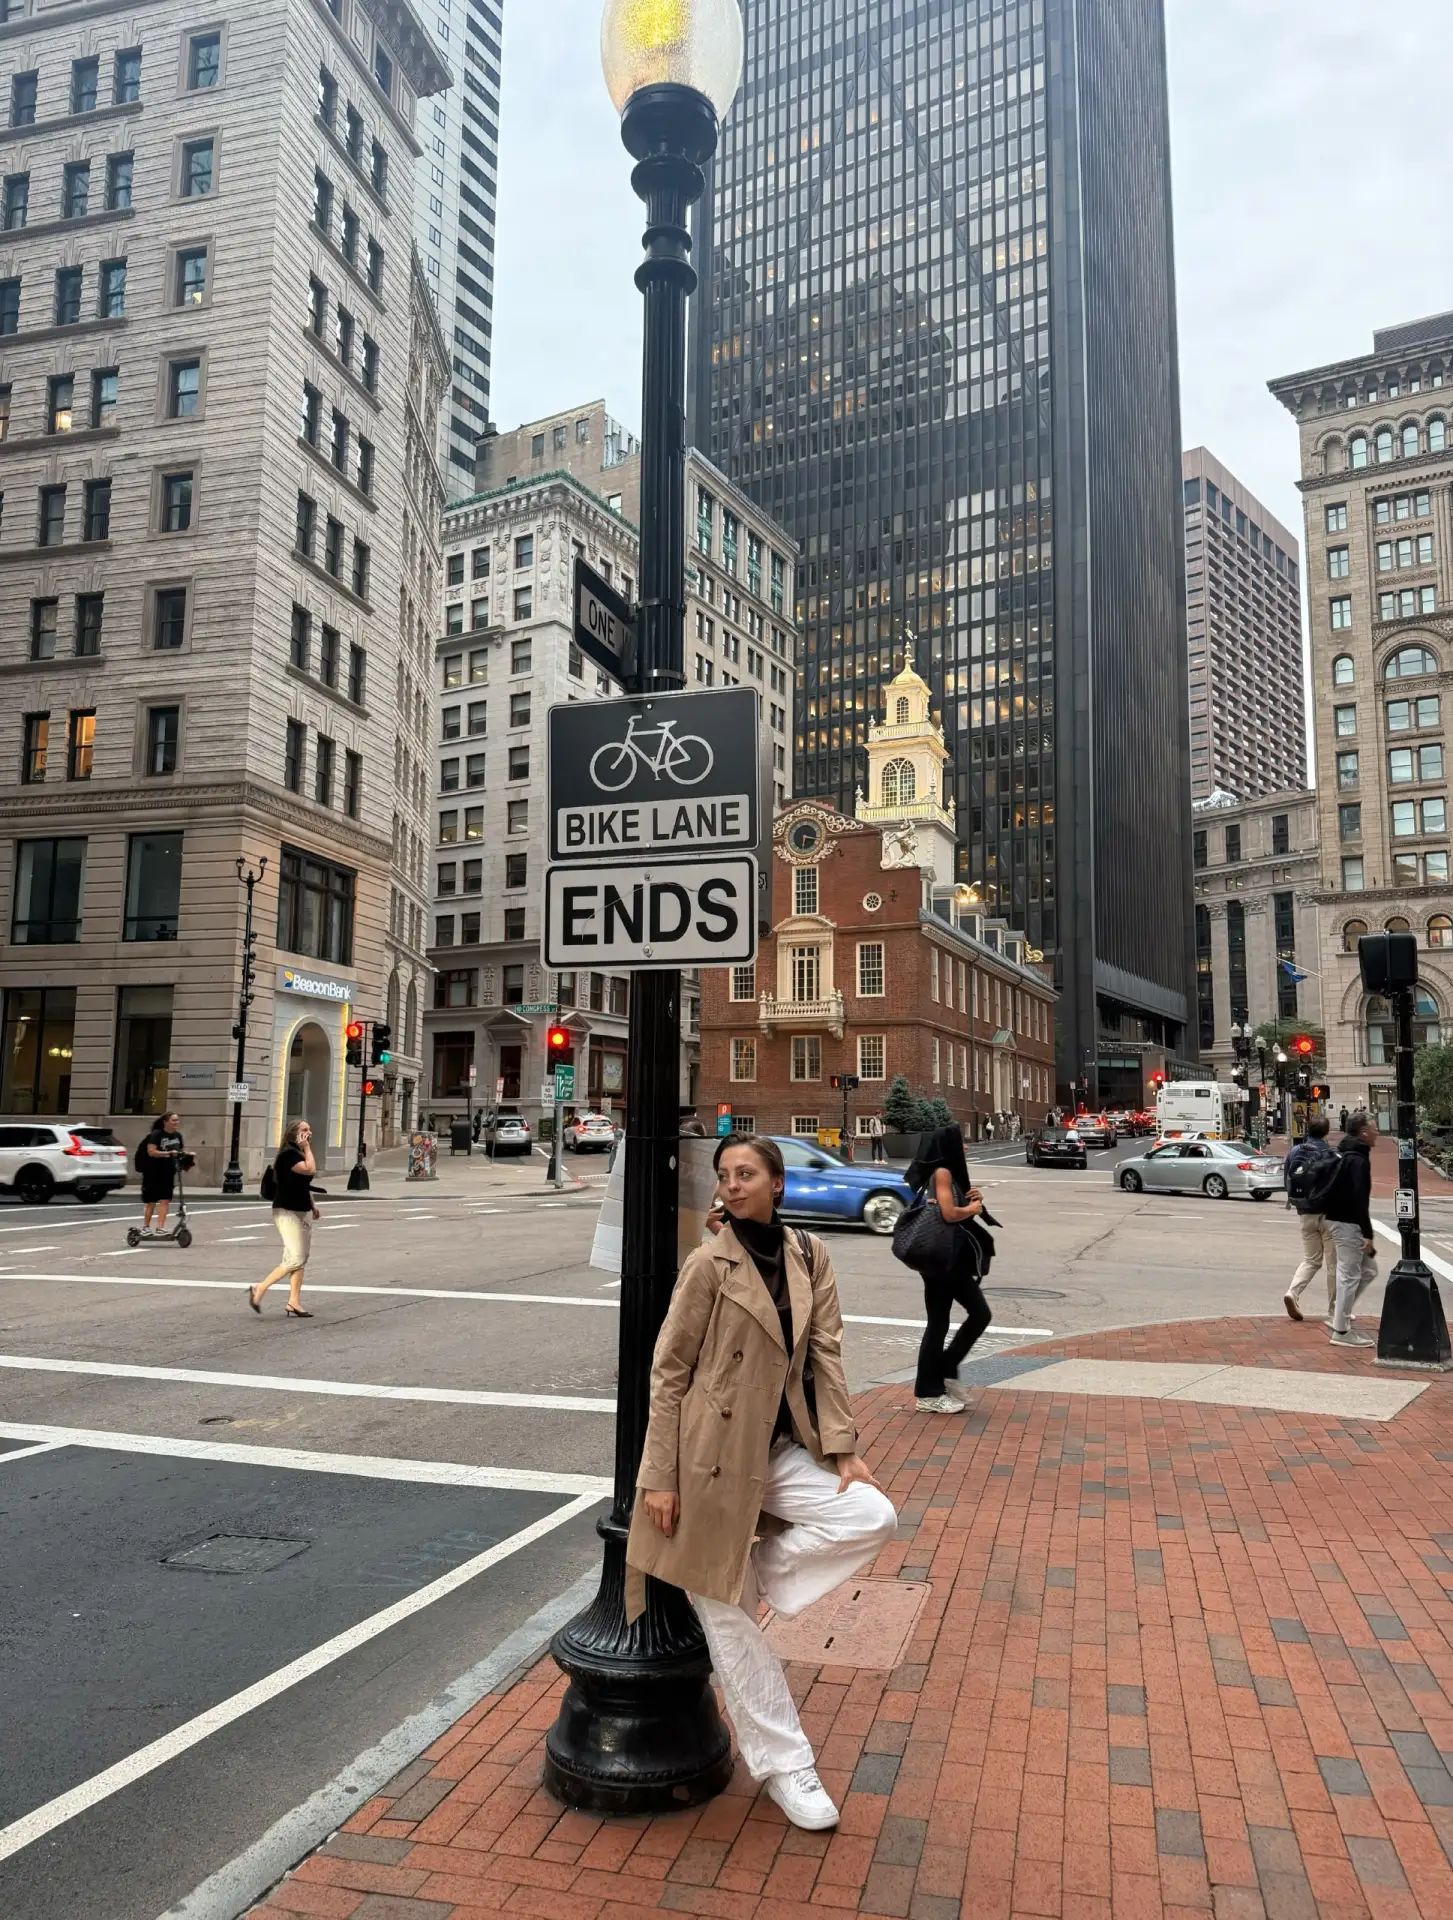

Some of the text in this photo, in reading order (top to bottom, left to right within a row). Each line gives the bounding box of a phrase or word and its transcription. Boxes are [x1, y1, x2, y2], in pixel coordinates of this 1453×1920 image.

[588, 599, 615, 648] ONE
[566, 801, 740, 846] BIKE LANE
[562, 877, 739, 946] ENDS
[293, 974, 352, 1000] BeaconBank
